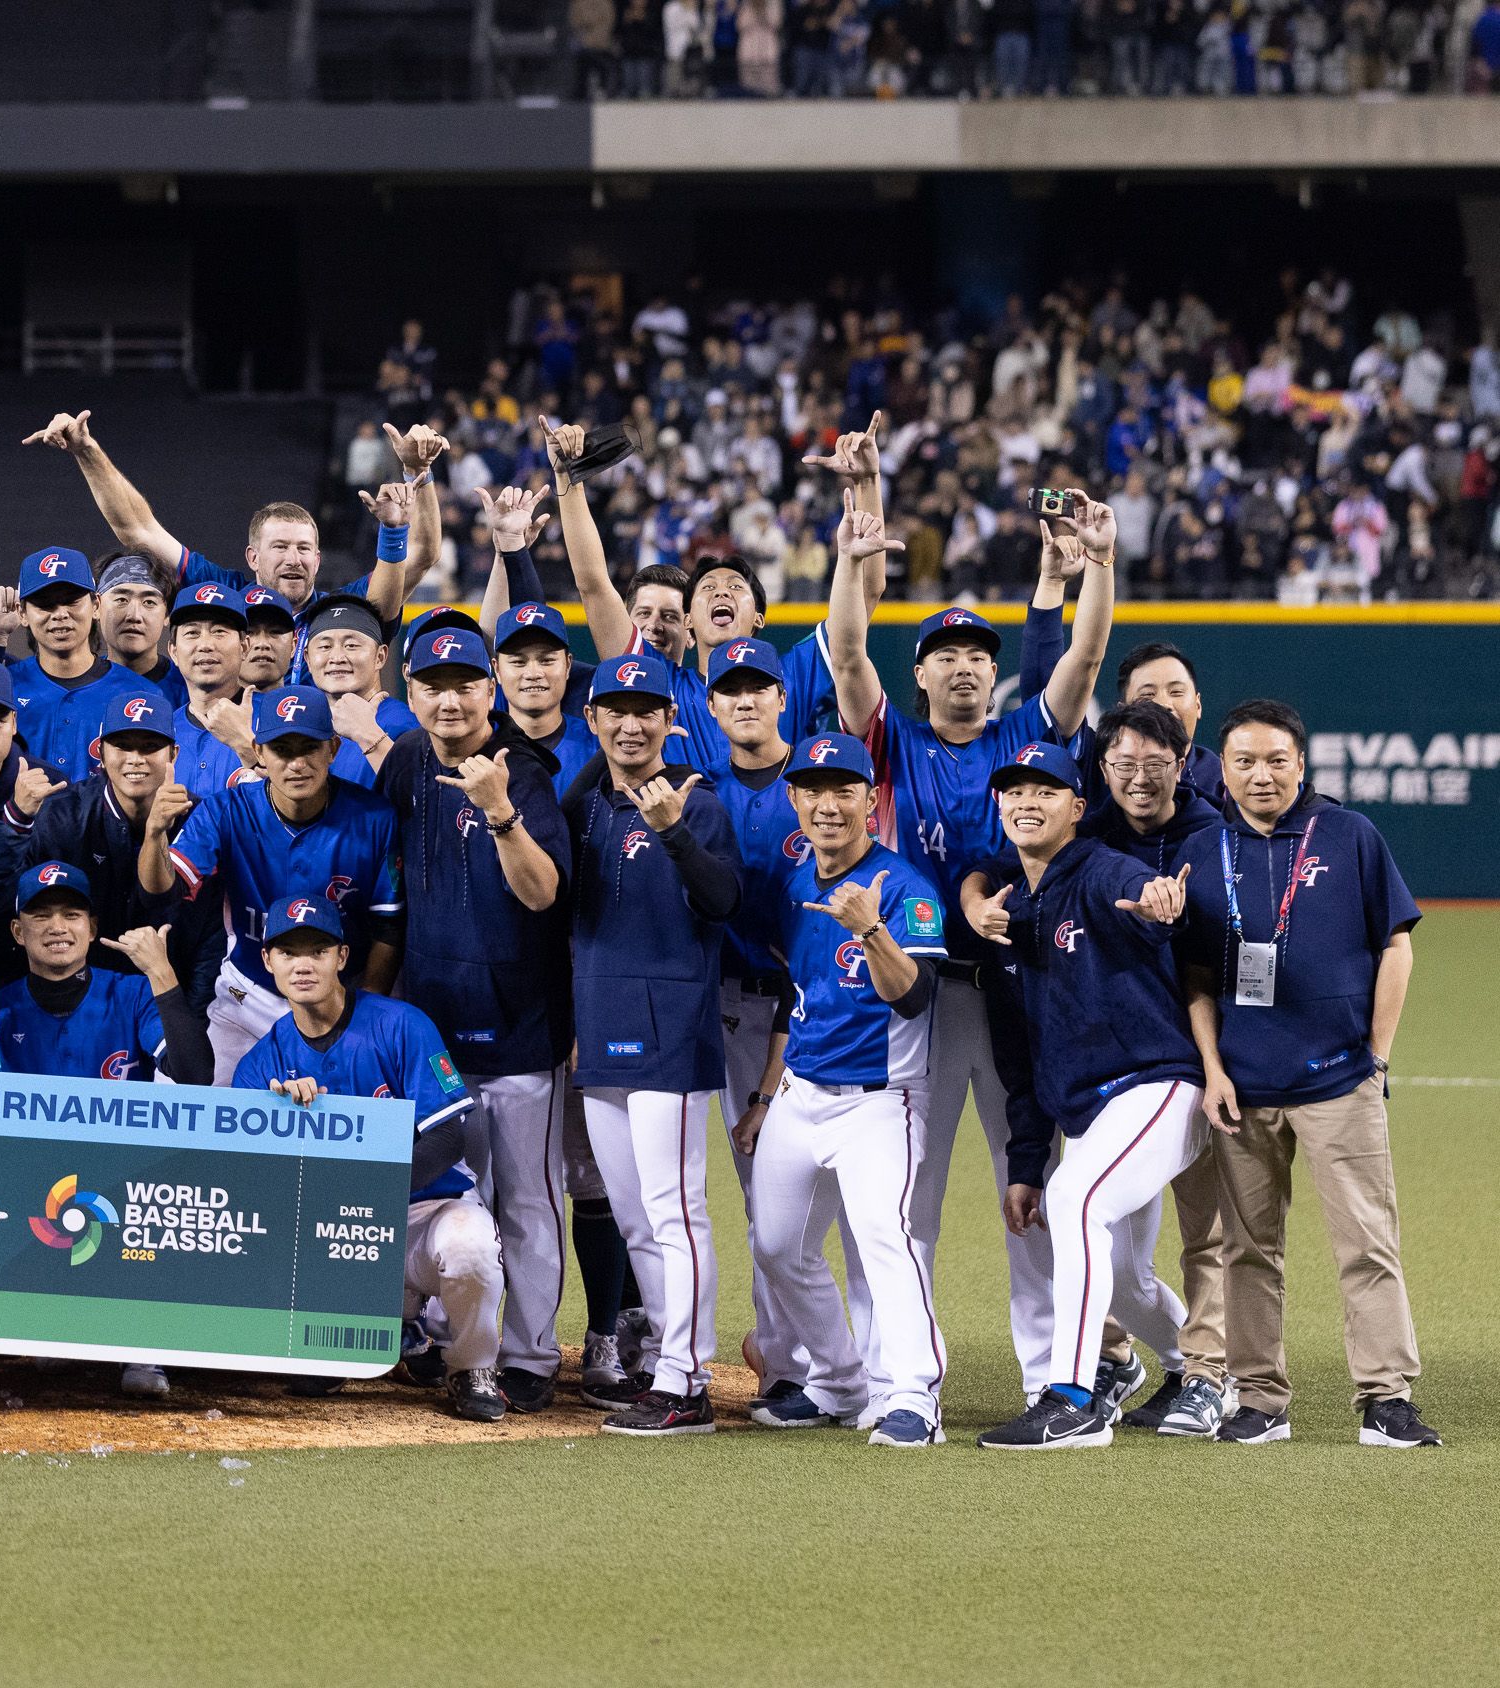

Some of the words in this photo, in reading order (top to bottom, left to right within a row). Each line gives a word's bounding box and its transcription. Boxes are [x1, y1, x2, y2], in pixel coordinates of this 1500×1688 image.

[214, 1105, 365, 1143] BOUND!
[125, 1181, 229, 1209] WORLD
[124, 1203, 267, 1234] BASEBALL
[339, 1205, 374, 1218] DATE
[122, 1227, 243, 1254] CLASSIC
[316, 1222, 395, 1243] MARCH
[121, 1248, 156, 1261] 2026
[328, 1242, 380, 1262] 2026
